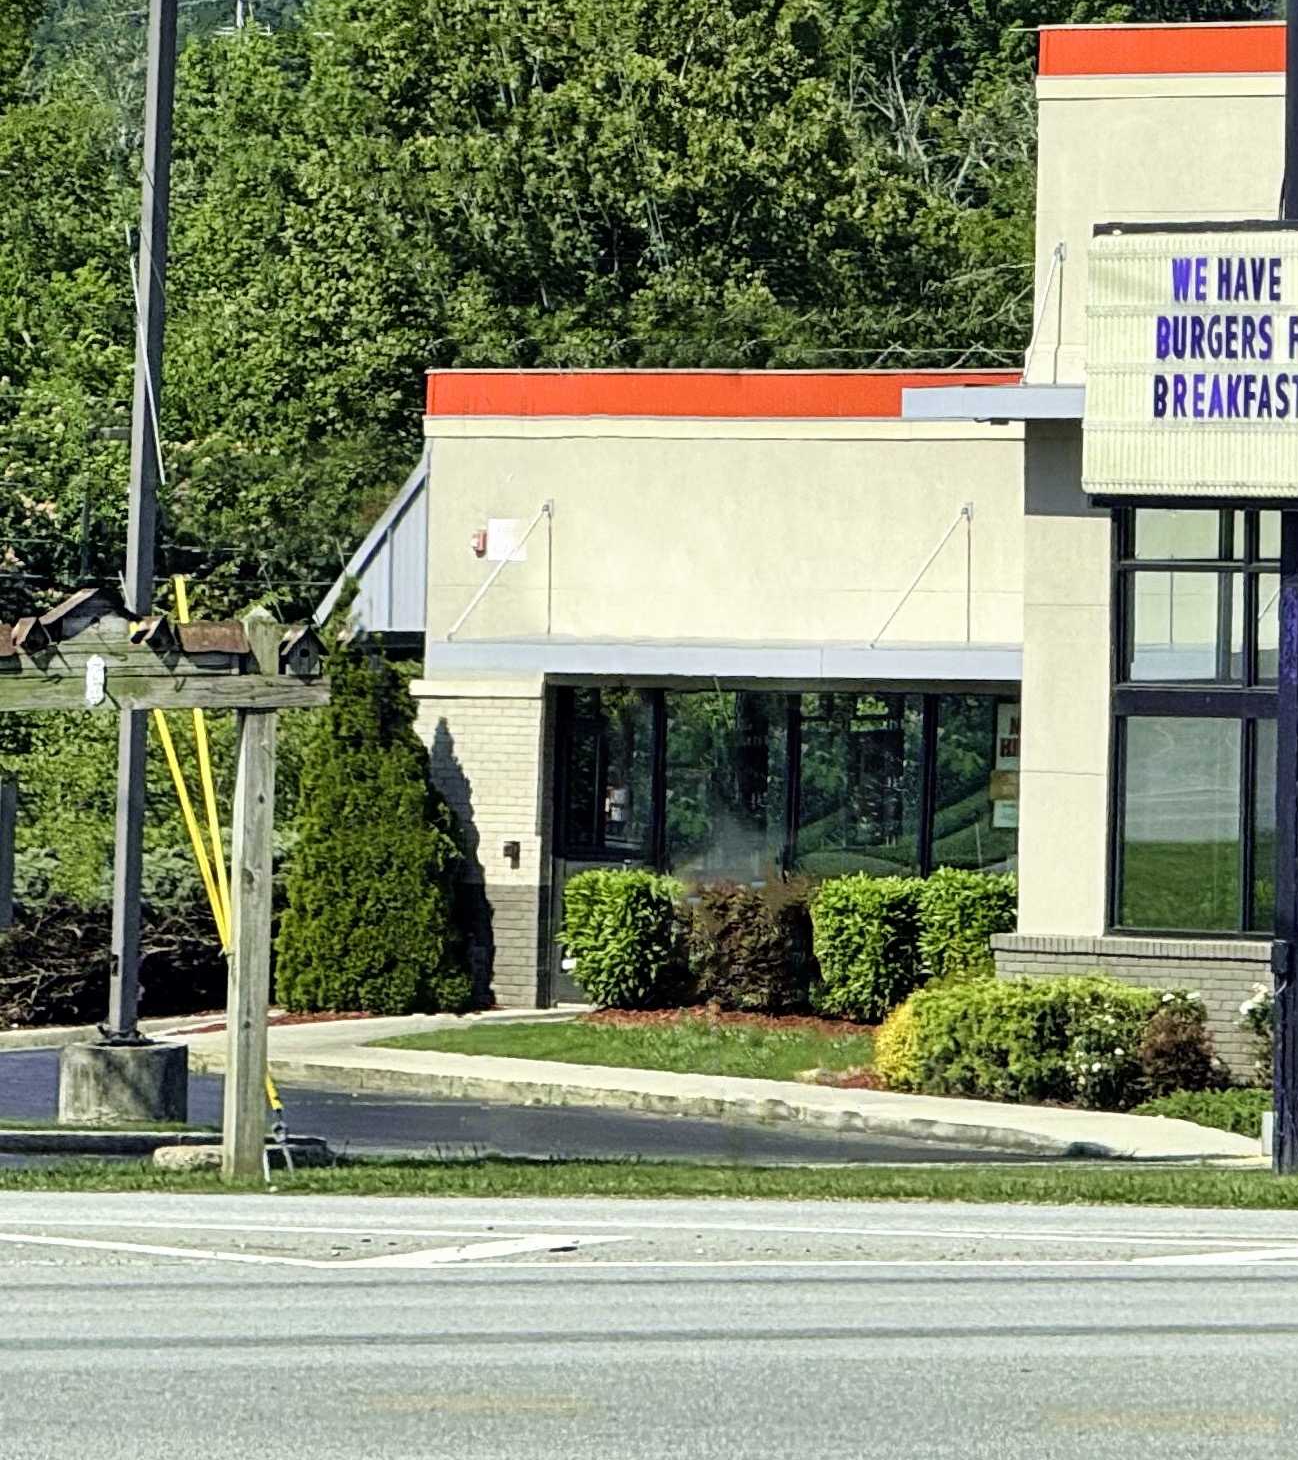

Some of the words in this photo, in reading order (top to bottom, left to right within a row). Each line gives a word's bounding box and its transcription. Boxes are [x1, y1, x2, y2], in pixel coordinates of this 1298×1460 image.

[1171, 257, 1207, 302] WE
[1217, 257, 1282, 302] HAVE
[1155, 315, 1273, 360] BURGERS
